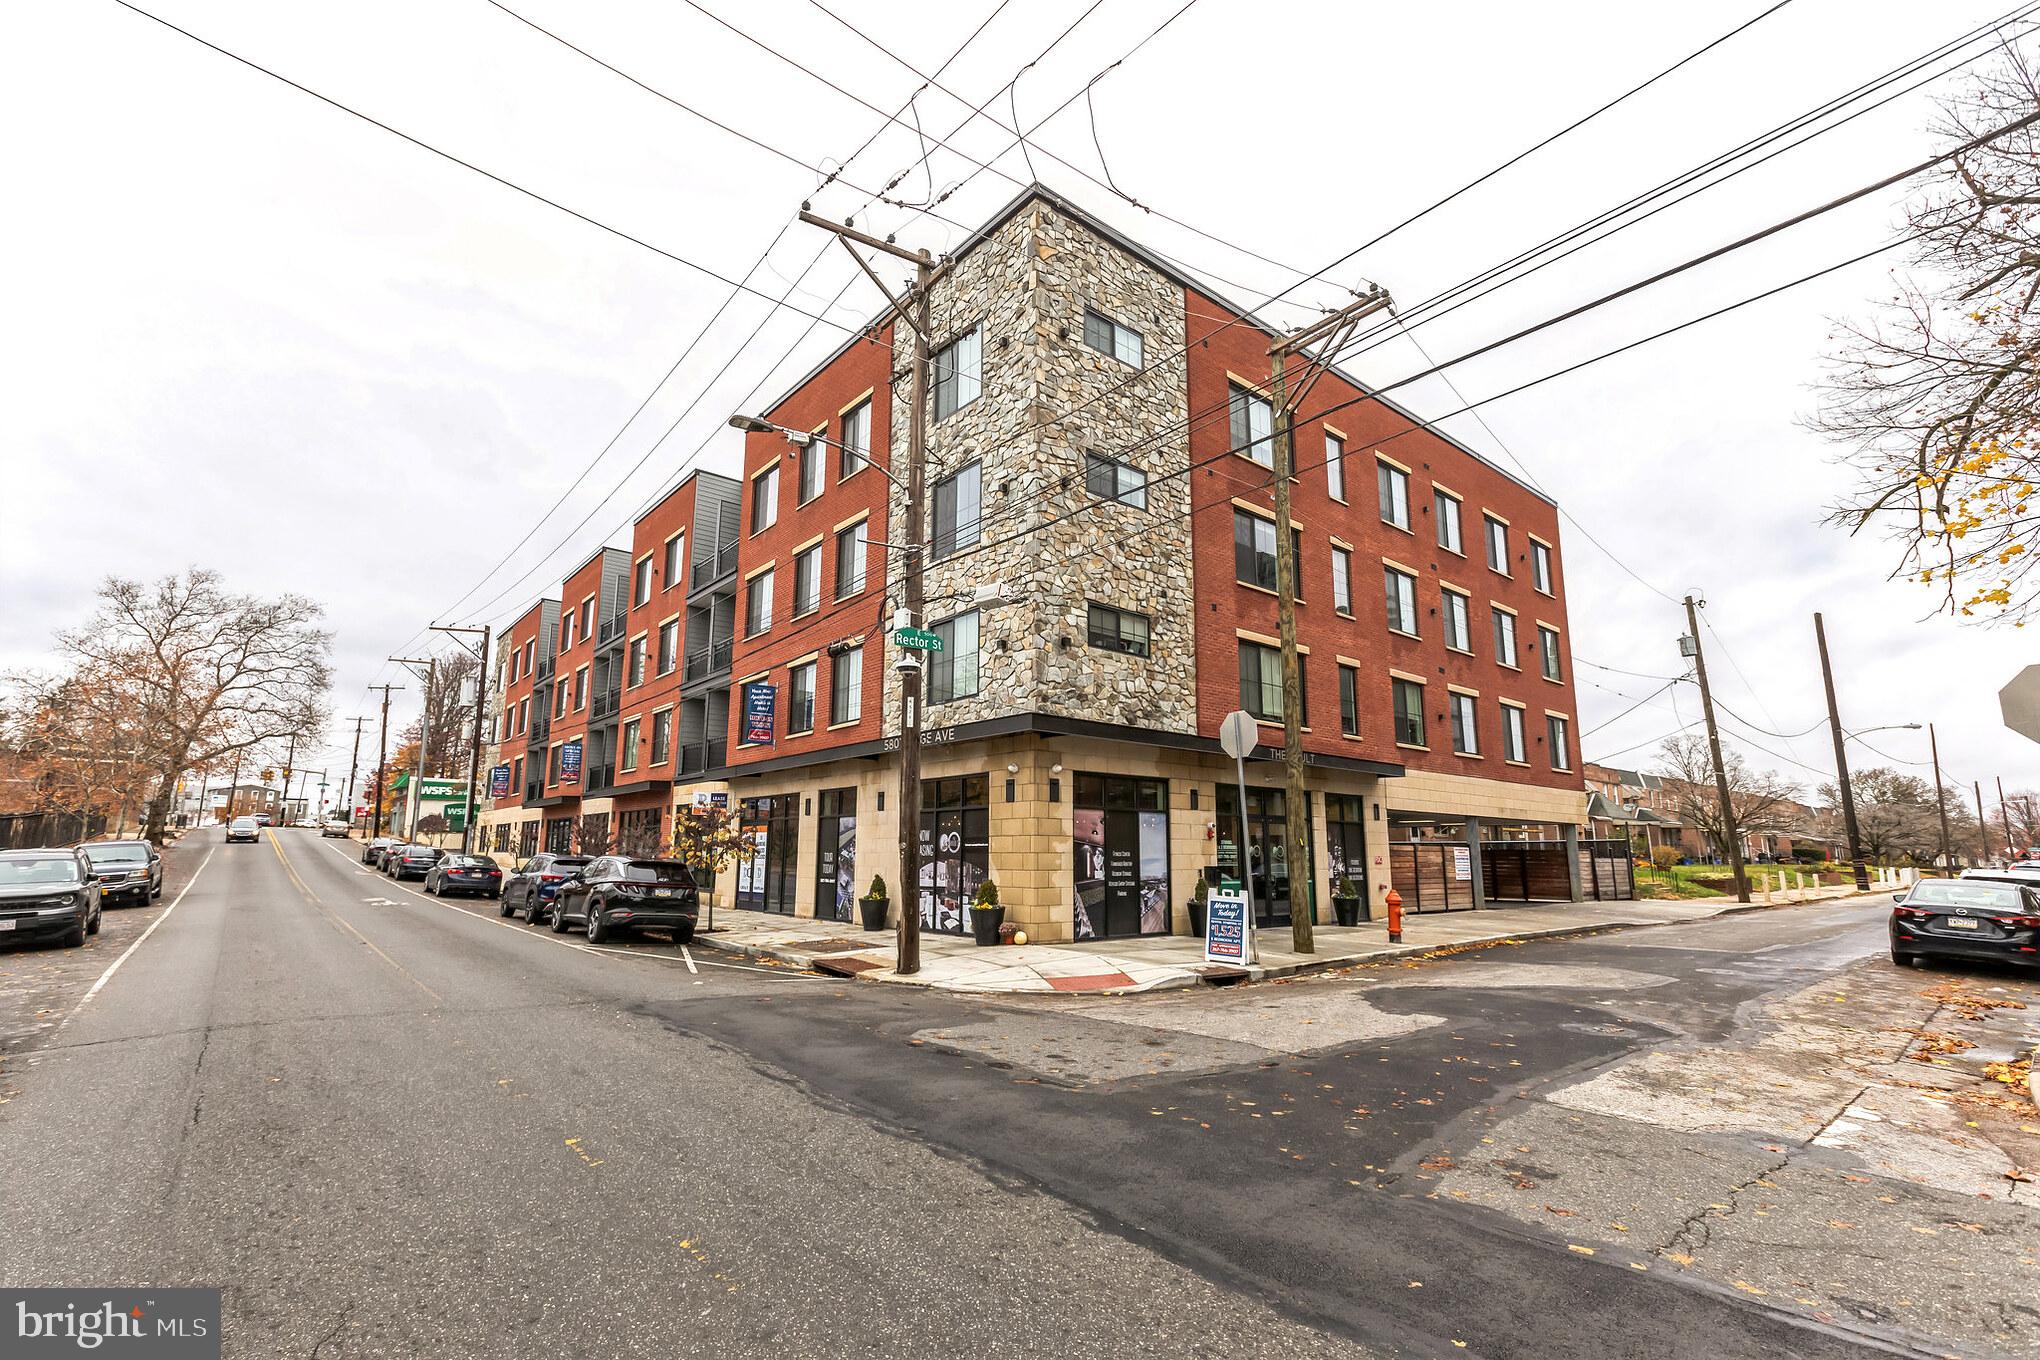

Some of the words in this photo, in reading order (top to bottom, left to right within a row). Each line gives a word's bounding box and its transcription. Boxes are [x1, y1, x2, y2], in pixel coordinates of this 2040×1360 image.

[896, 633, 929, 647] Rector
[932, 639, 942, 650] St
[884, 738, 902, 751] 580
[934, 728, 955, 743] AVE
[1270, 749, 1286, 760] THE
[919, 845, 934, 857] ASING
[1218, 910, 1240, 919] Today!
